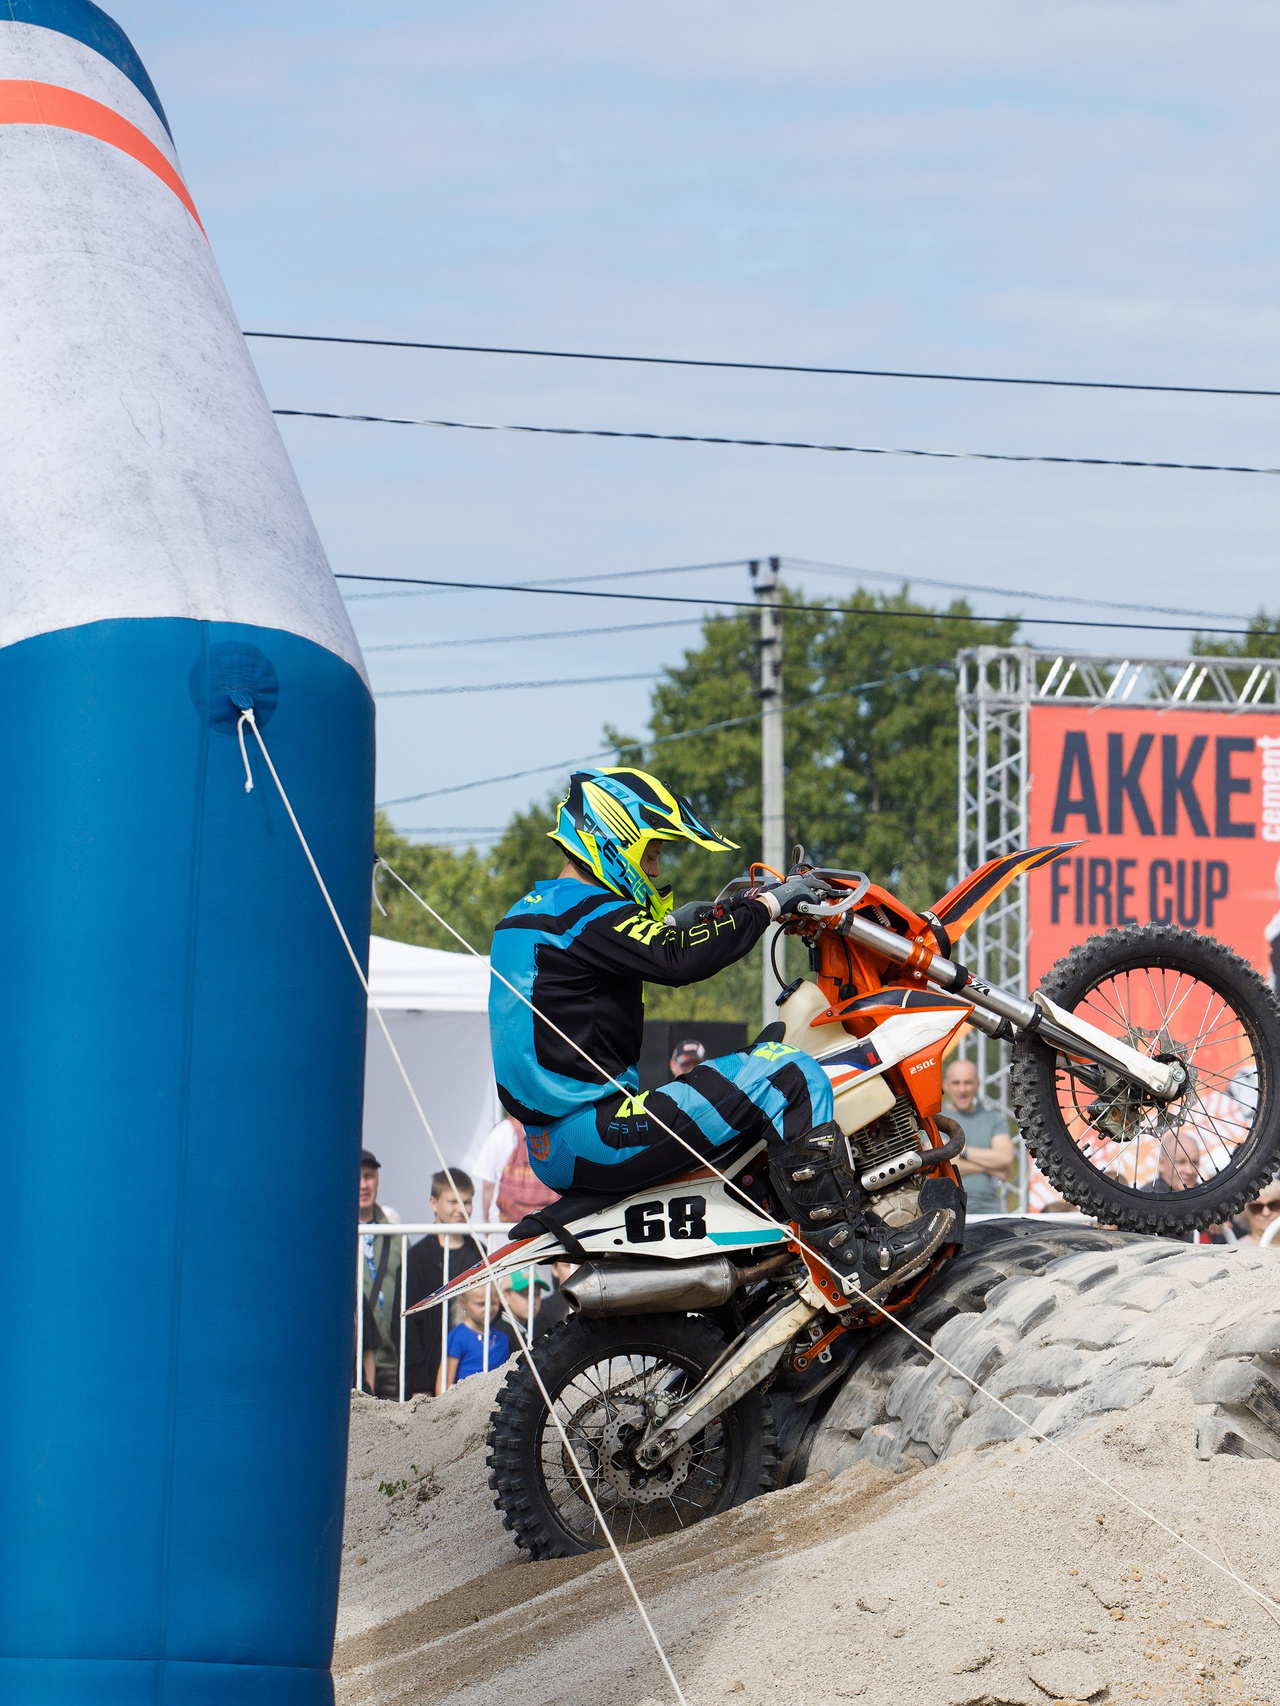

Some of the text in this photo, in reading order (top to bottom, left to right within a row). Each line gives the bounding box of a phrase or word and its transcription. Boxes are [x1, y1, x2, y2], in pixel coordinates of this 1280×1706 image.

[1049, 856, 1137, 926] FIRE
[1148, 859, 1230, 928] CUP
[624, 1195, 708, 1244] 68
